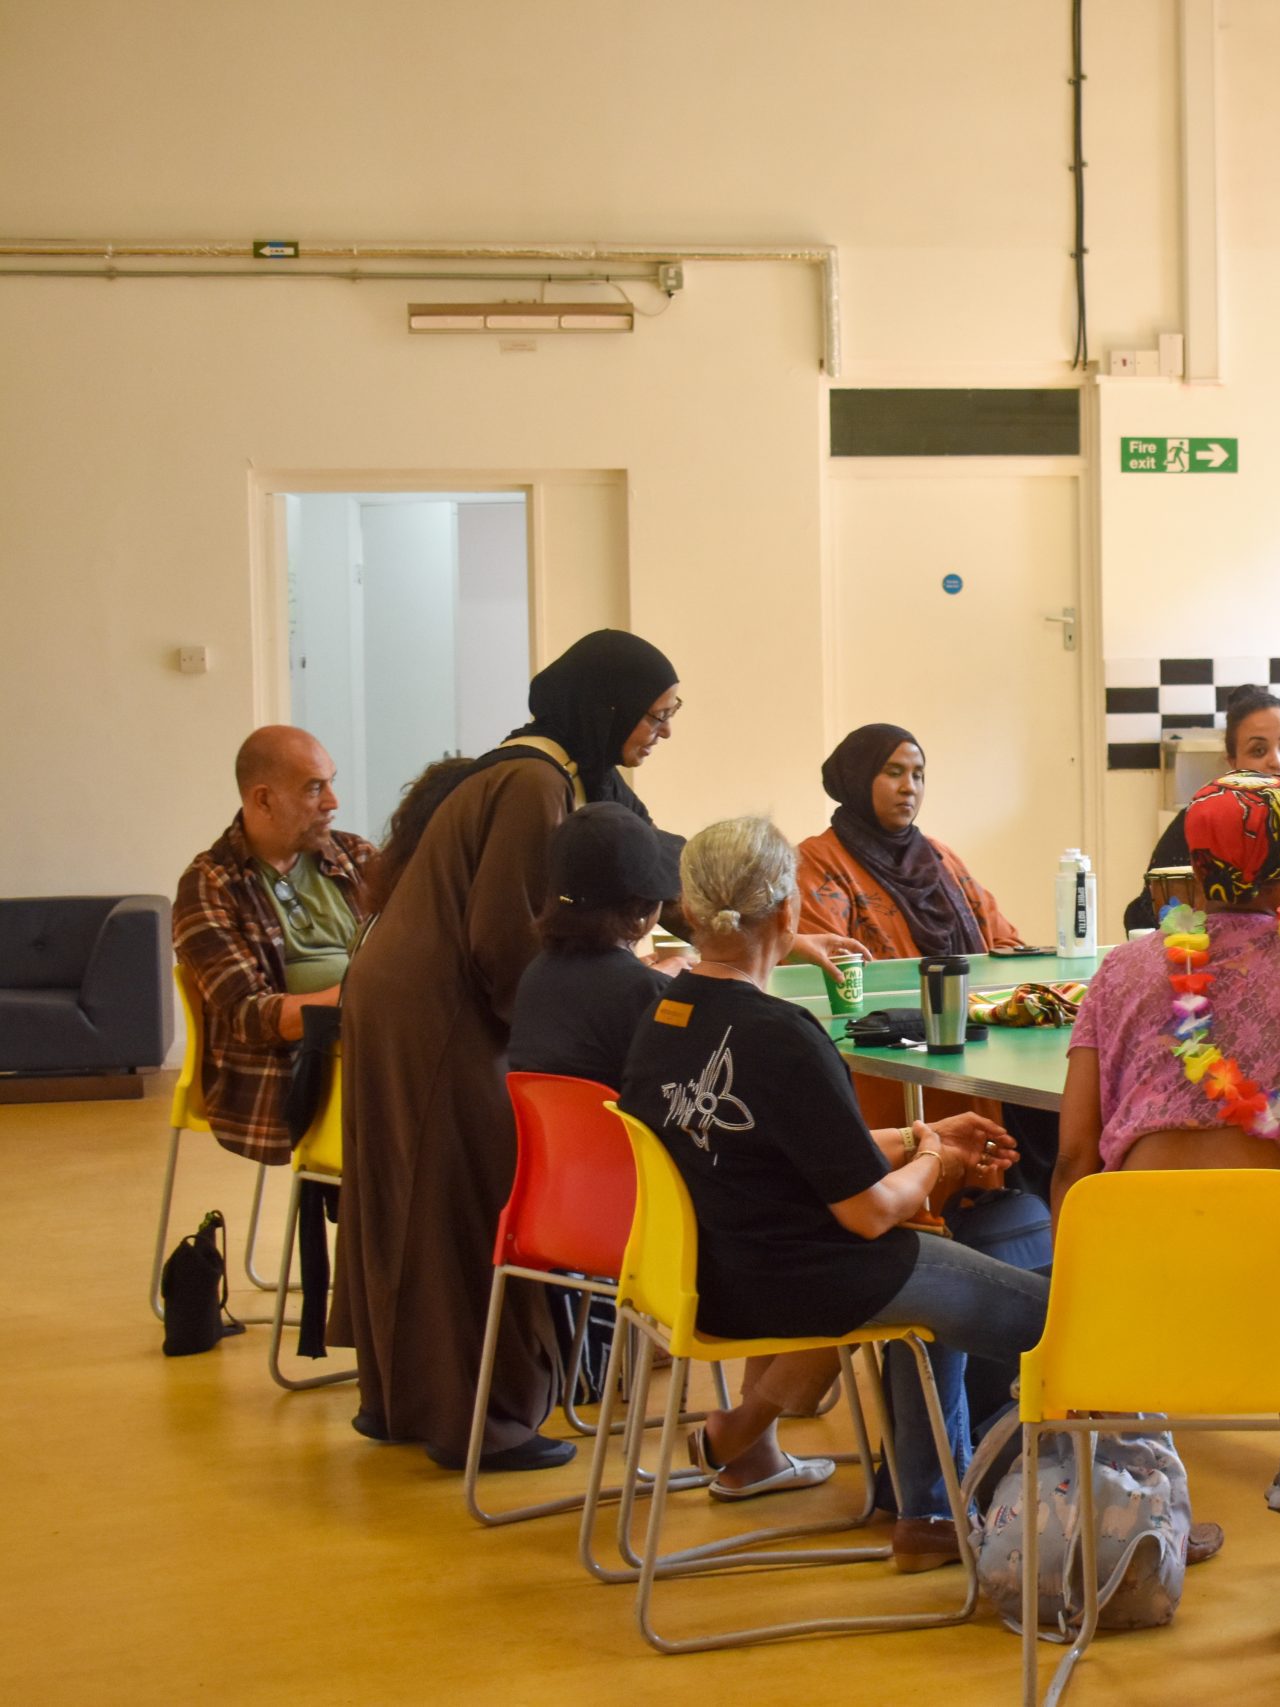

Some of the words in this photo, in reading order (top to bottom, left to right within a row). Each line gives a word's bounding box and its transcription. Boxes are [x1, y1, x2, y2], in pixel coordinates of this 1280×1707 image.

[1129, 440, 1157, 453] Fire
[1129, 457, 1156, 469] exit
[1077, 886, 1085, 906] SPORT
[1078, 910, 1086, 933] BOTTLE
